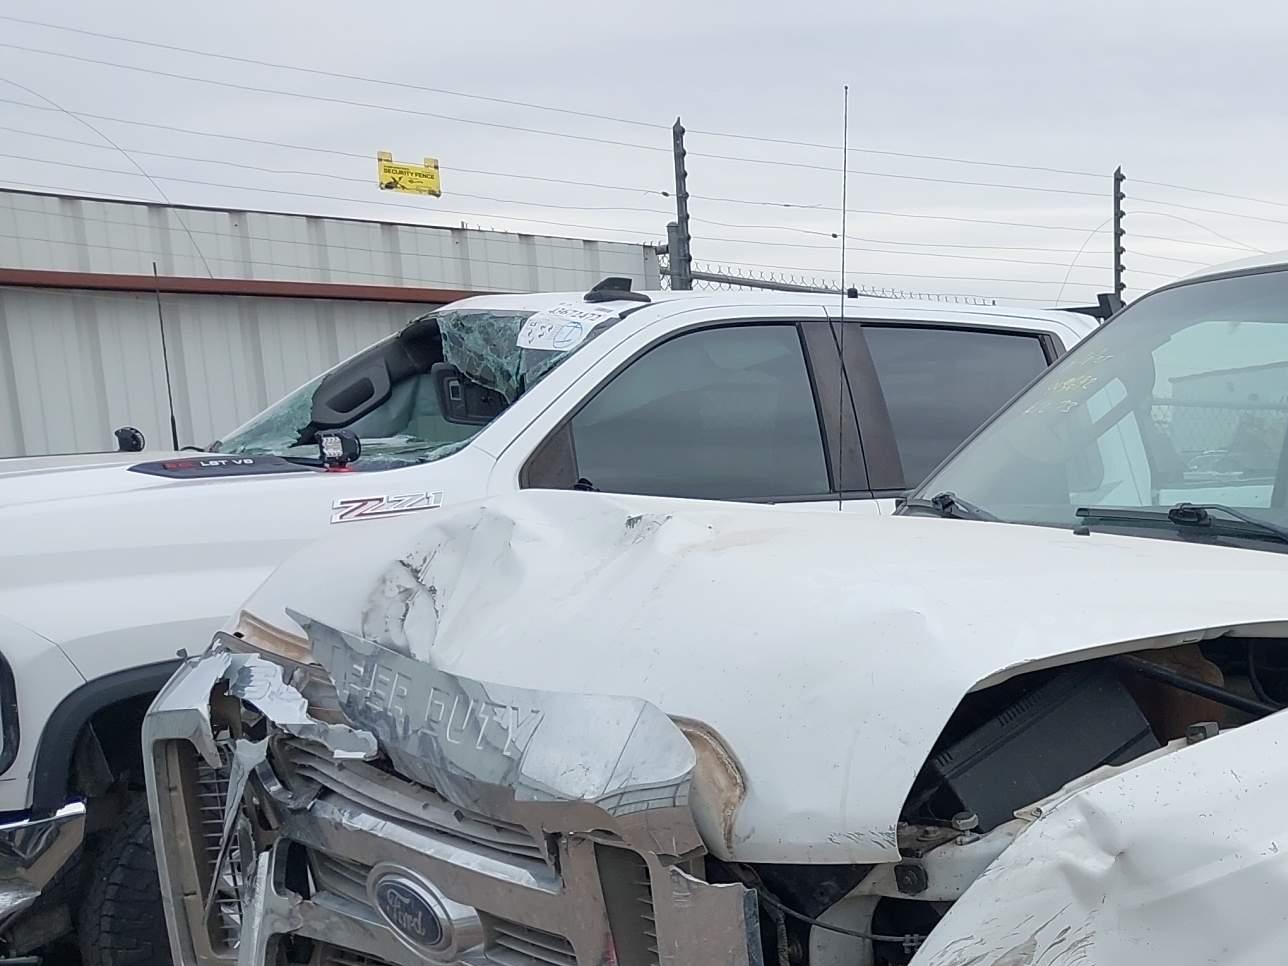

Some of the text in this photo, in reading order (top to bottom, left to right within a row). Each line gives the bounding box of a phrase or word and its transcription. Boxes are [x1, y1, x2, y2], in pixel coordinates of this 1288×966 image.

[383, 167, 414, 177] SECURITY
[414, 171, 435, 180] FENCE
[386, 888, 426, 936] Ford
